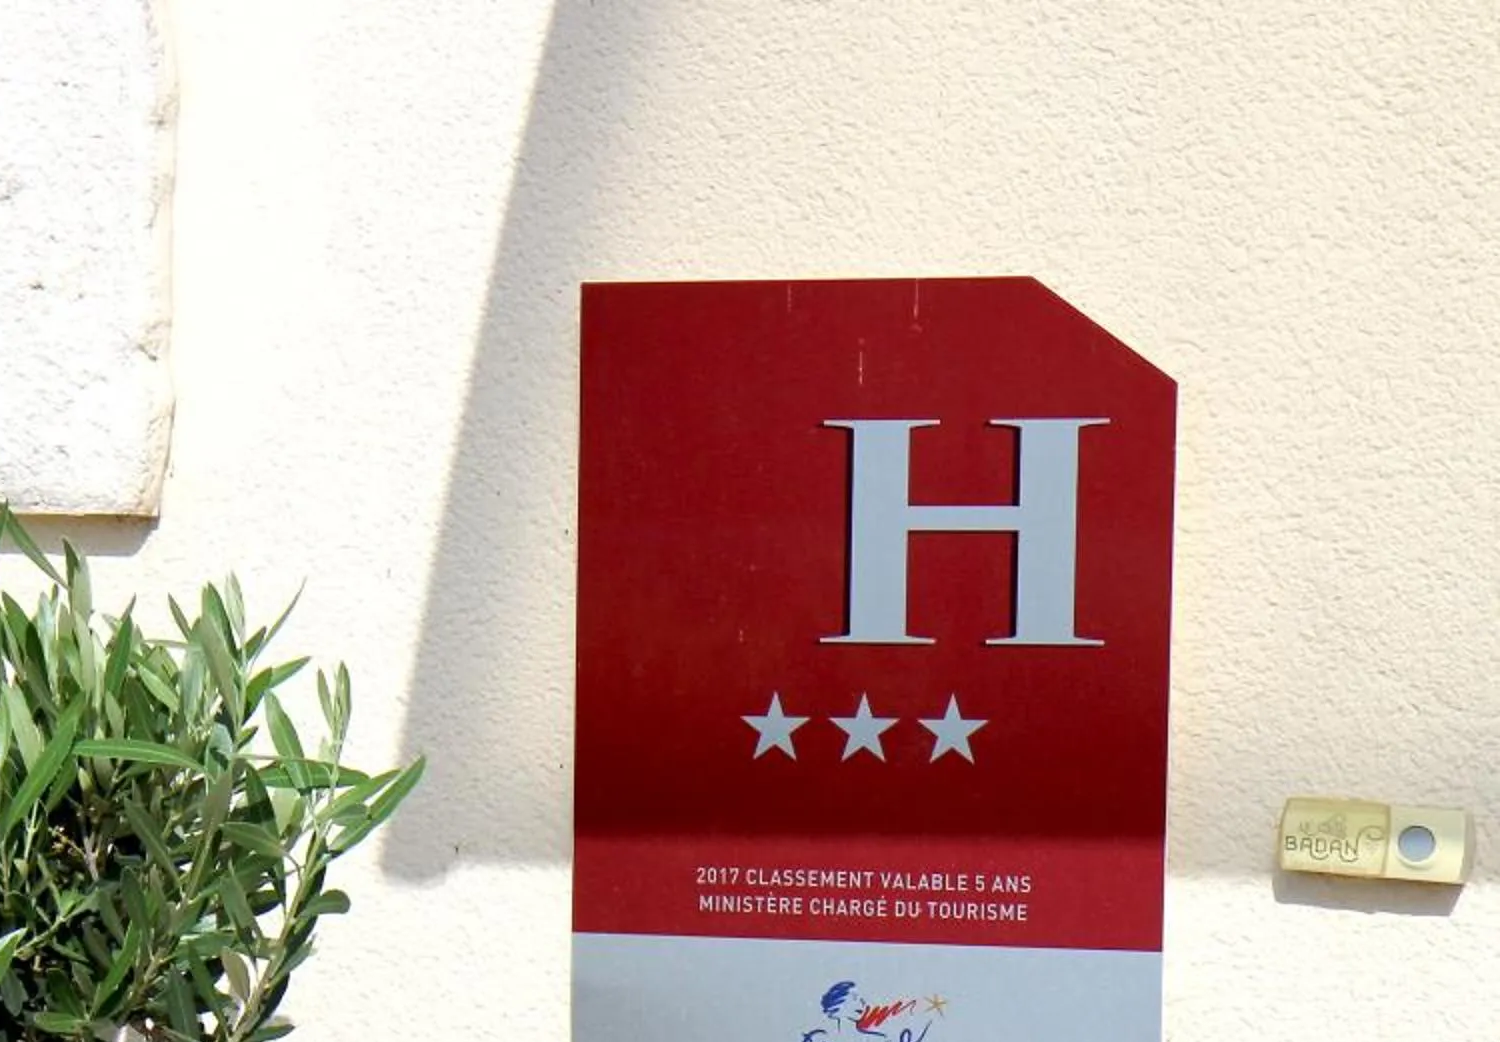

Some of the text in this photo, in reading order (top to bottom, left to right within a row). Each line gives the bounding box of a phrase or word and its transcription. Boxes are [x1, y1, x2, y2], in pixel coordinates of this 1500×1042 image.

[818, 417, 1111, 646] H
[696, 867, 1032, 894] 2017 CLASSEMENT VALABLE 5 ANS
[699, 891, 1028, 921] MINISTÈRE CHARGÉ DU TOURISME
